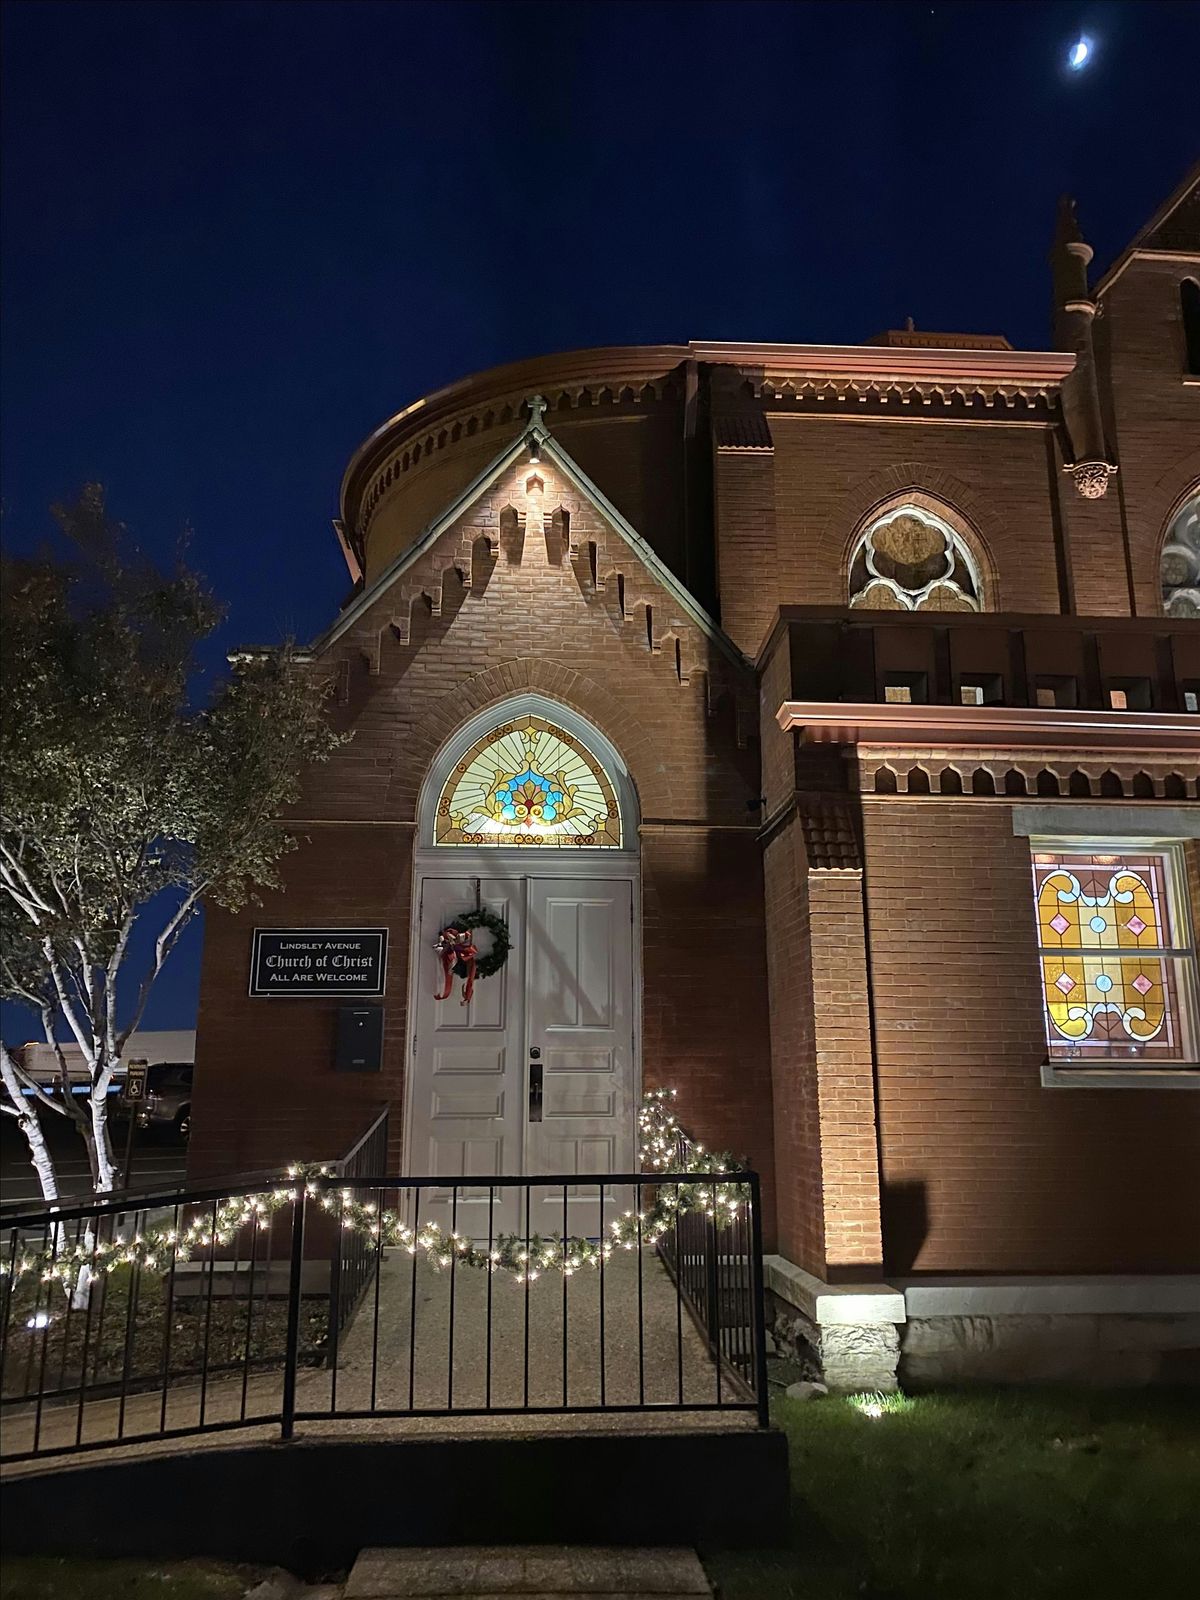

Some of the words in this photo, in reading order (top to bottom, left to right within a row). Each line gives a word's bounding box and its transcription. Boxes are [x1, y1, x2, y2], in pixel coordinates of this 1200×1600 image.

[280, 942, 322, 950] LINDSLEY
[325, 942, 361, 950] AVENUE
[266, 955, 312, 969] Church
[316, 956, 328, 967] of
[332, 955, 373, 969] Christ
